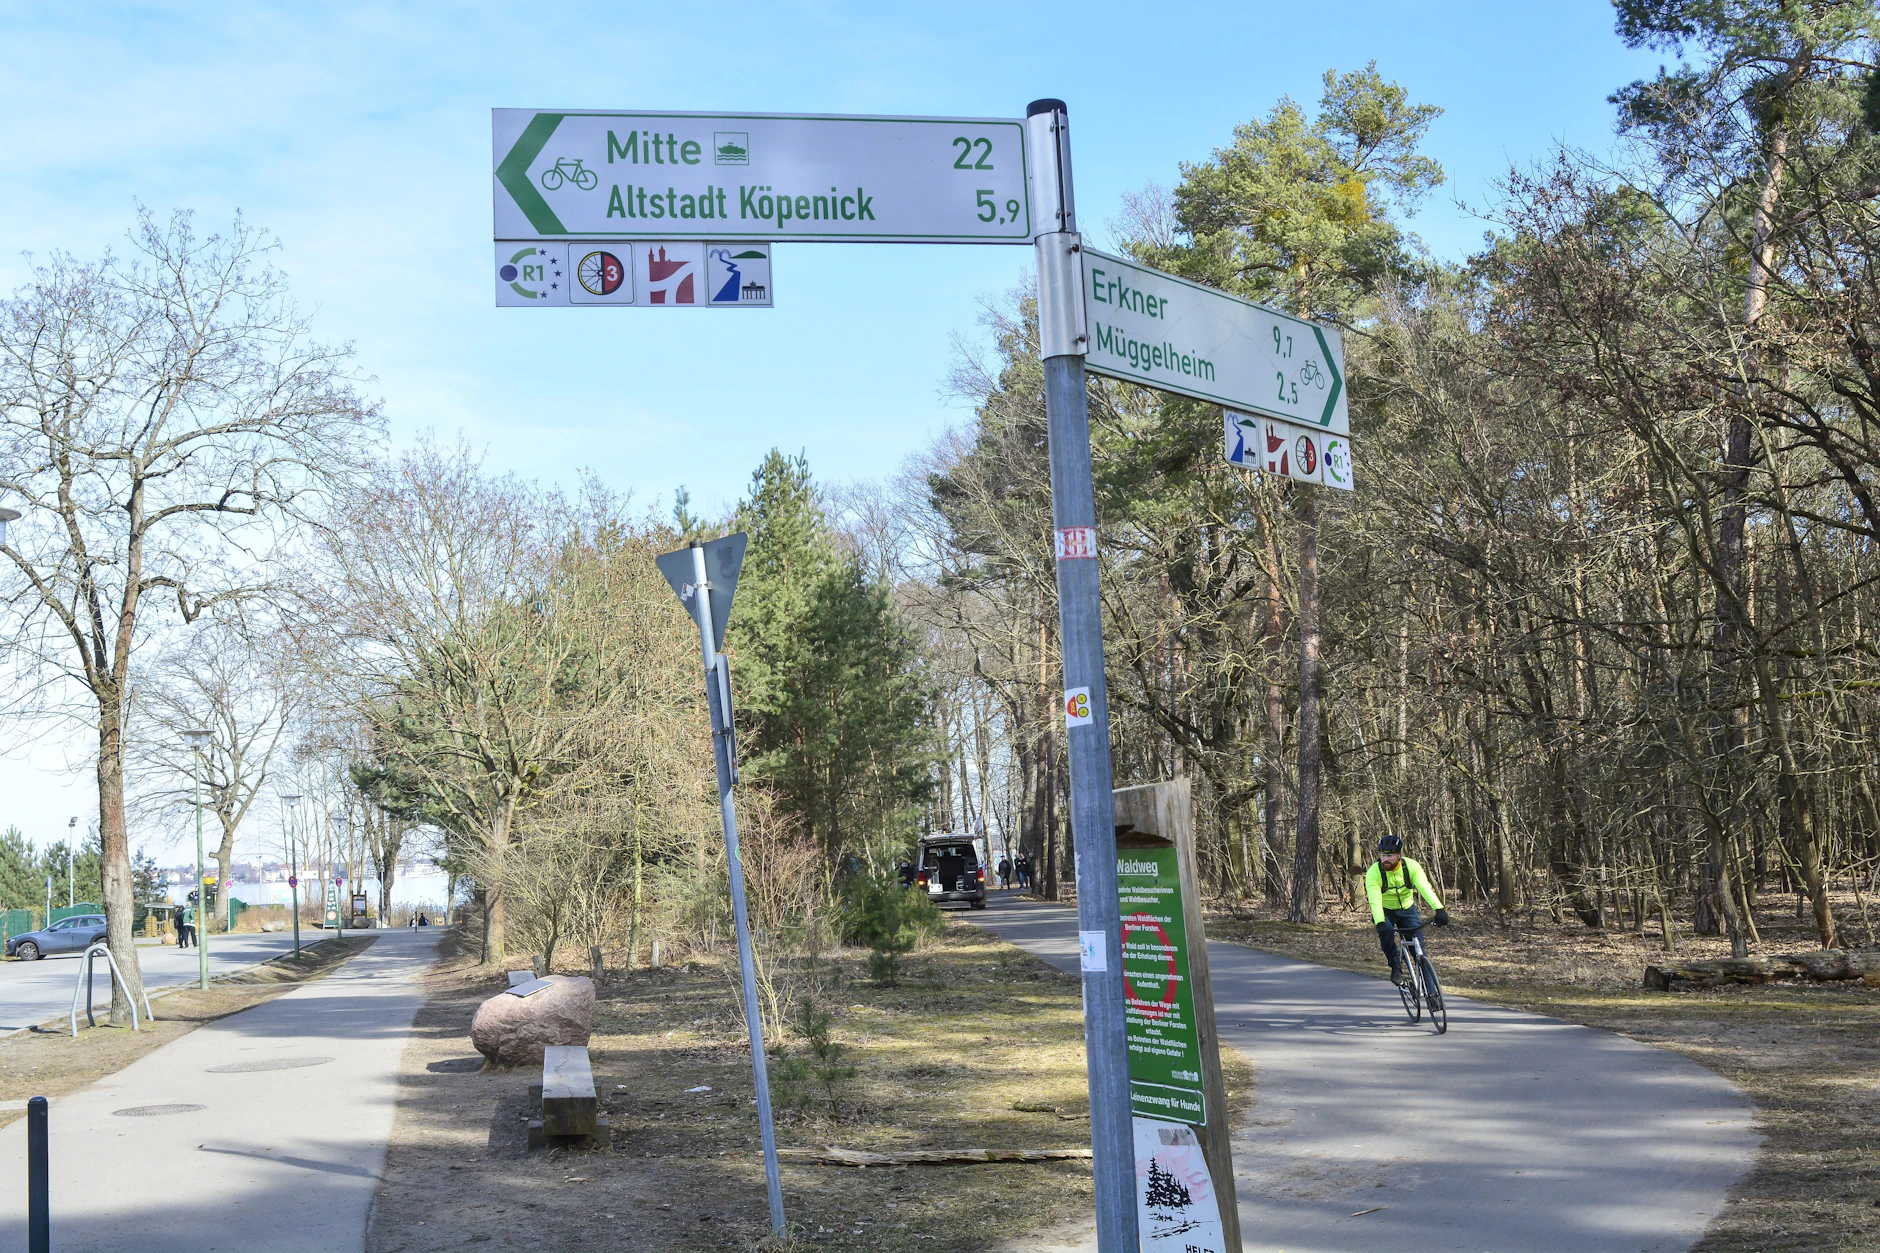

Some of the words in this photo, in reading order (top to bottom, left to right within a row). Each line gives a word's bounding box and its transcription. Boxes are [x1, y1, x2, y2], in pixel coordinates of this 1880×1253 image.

[607, 130, 701, 165] Mitte
[952, 137, 994, 170] 22
[606, 184, 727, 219] Altstadt
[740, 185, 876, 229] Köpenick
[976, 189, 1020, 225] 5,9
[523, 265, 543, 282] R1
[606, 265, 618, 282] 3
[1092, 268, 1168, 320] Erkner
[1272, 325, 1293, 359] 9,7
[1095, 322, 1215, 382] Müggelheim
[1276, 371, 1298, 405] 2,5
[1307, 450, 1314, 462] 3
[1333, 454, 1344, 470] R1
[1137, 952, 1157, 962] Erholung
[1156, 973, 1183, 981] angenehmen
[1126, 1007, 1157, 1017] raftfahrzeugen
[1159, 1001, 1171, 1009] Wege
[1152, 1019, 1168, 1027] Berliner
[1170, 1021, 1186, 1029] Forsten
[1129, 1044, 1143, 1053] erfolgt
[1166, 1048, 1181, 1057] Gefahr
[1171, 1098, 1179, 1108] für
[1180, 1100, 1200, 1112] Hunde
